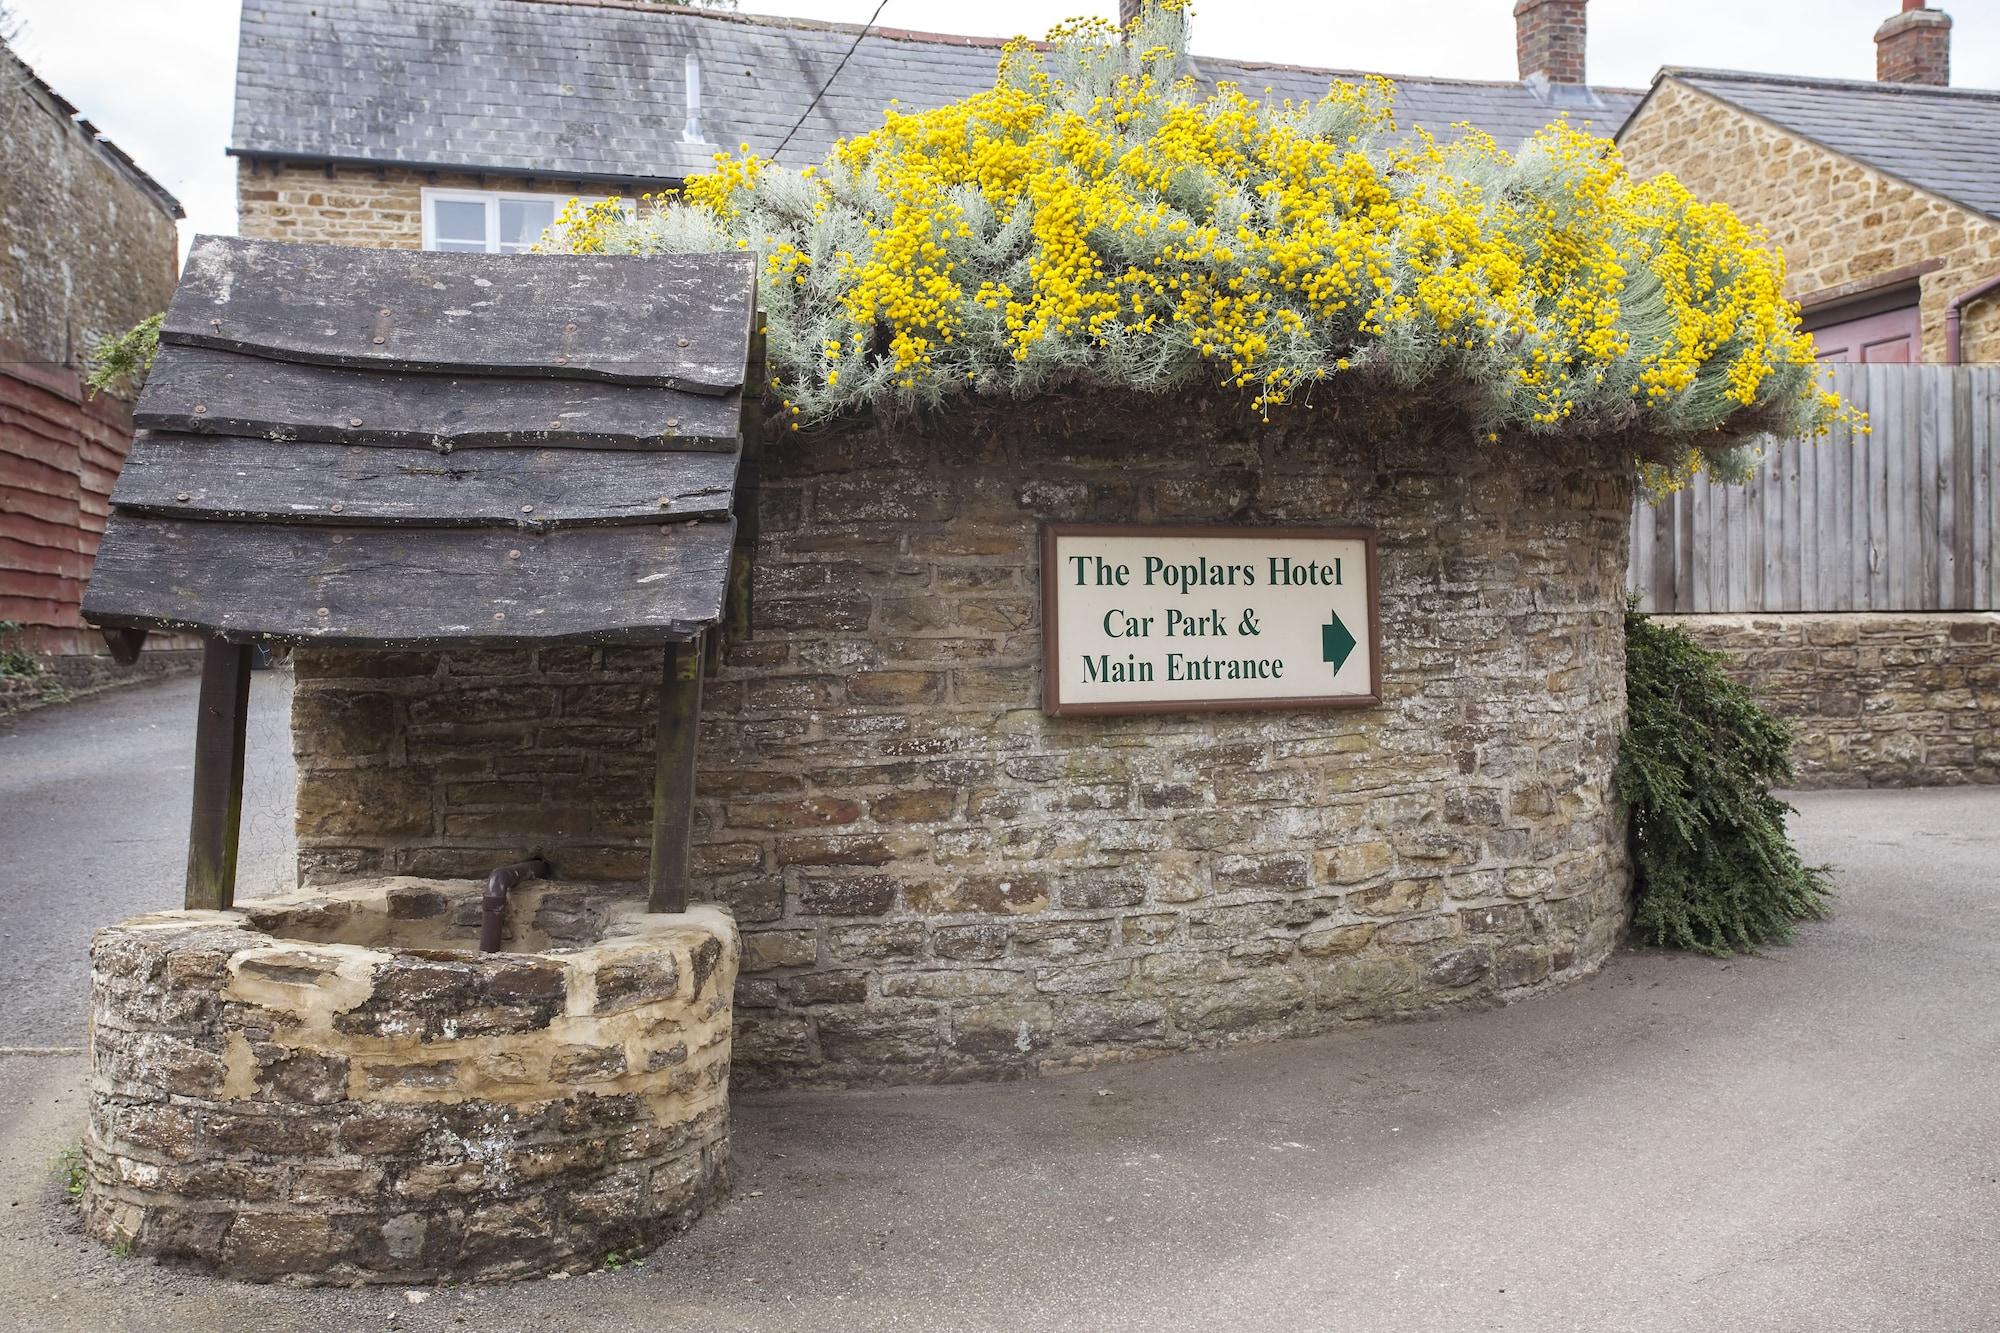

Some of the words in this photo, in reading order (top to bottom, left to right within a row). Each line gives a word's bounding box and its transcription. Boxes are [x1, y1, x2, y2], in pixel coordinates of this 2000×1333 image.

[1069, 556, 1129, 586] The
[1143, 557, 1254, 594] Poplars
[1267, 557, 1343, 585] Hotel
[1104, 609, 1153, 638] Car
[1165, 609, 1227, 636] Park
[1238, 608, 1260, 636] &
[1082, 654, 1154, 683] Main
[1166, 654, 1283, 681] Entrance
